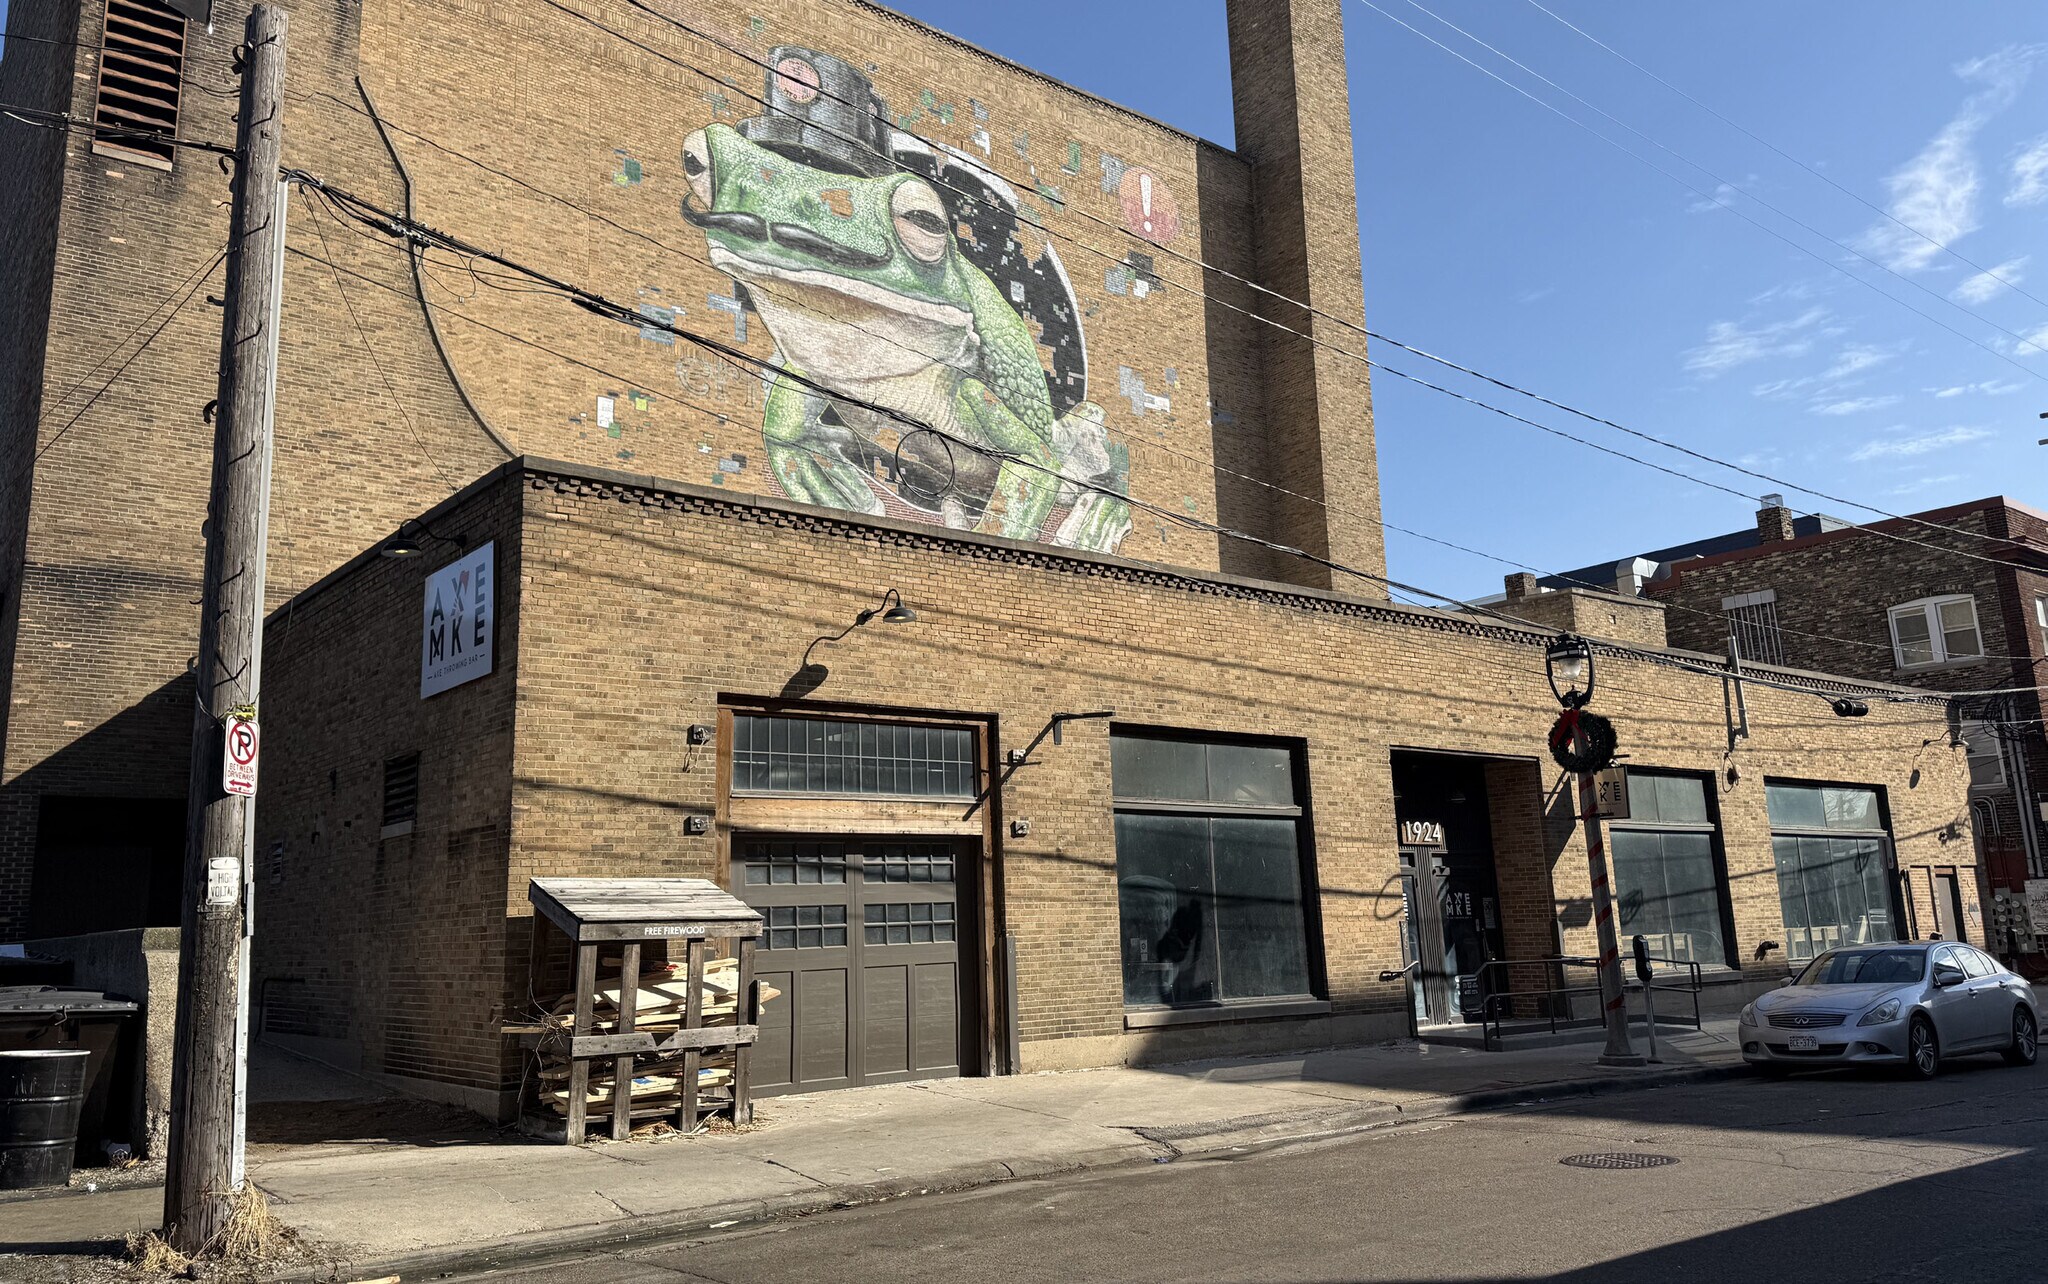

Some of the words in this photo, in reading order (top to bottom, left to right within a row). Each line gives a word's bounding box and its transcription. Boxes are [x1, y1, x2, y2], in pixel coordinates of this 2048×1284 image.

[431, 562, 486, 626] AXE
[429, 606, 486, 666] MKE
[434, 669, 442, 679] AXE
[444, 658, 467, 675] THROWING
[468, 654, 478, 665] BAR
[229, 762, 254, 774] BETWEEN
[227, 770, 255, 782] DRIVEWAYS
[1598, 781, 1621, 792] XE
[1600, 792, 1622, 802] KE
[1405, 820, 1441, 842] 1924
[1445, 892, 1471, 904] AXE
[1445, 904, 1472, 916] MKE
[644, 927, 662, 936] FREE
[664, 926, 705, 935] FIREWOOD
